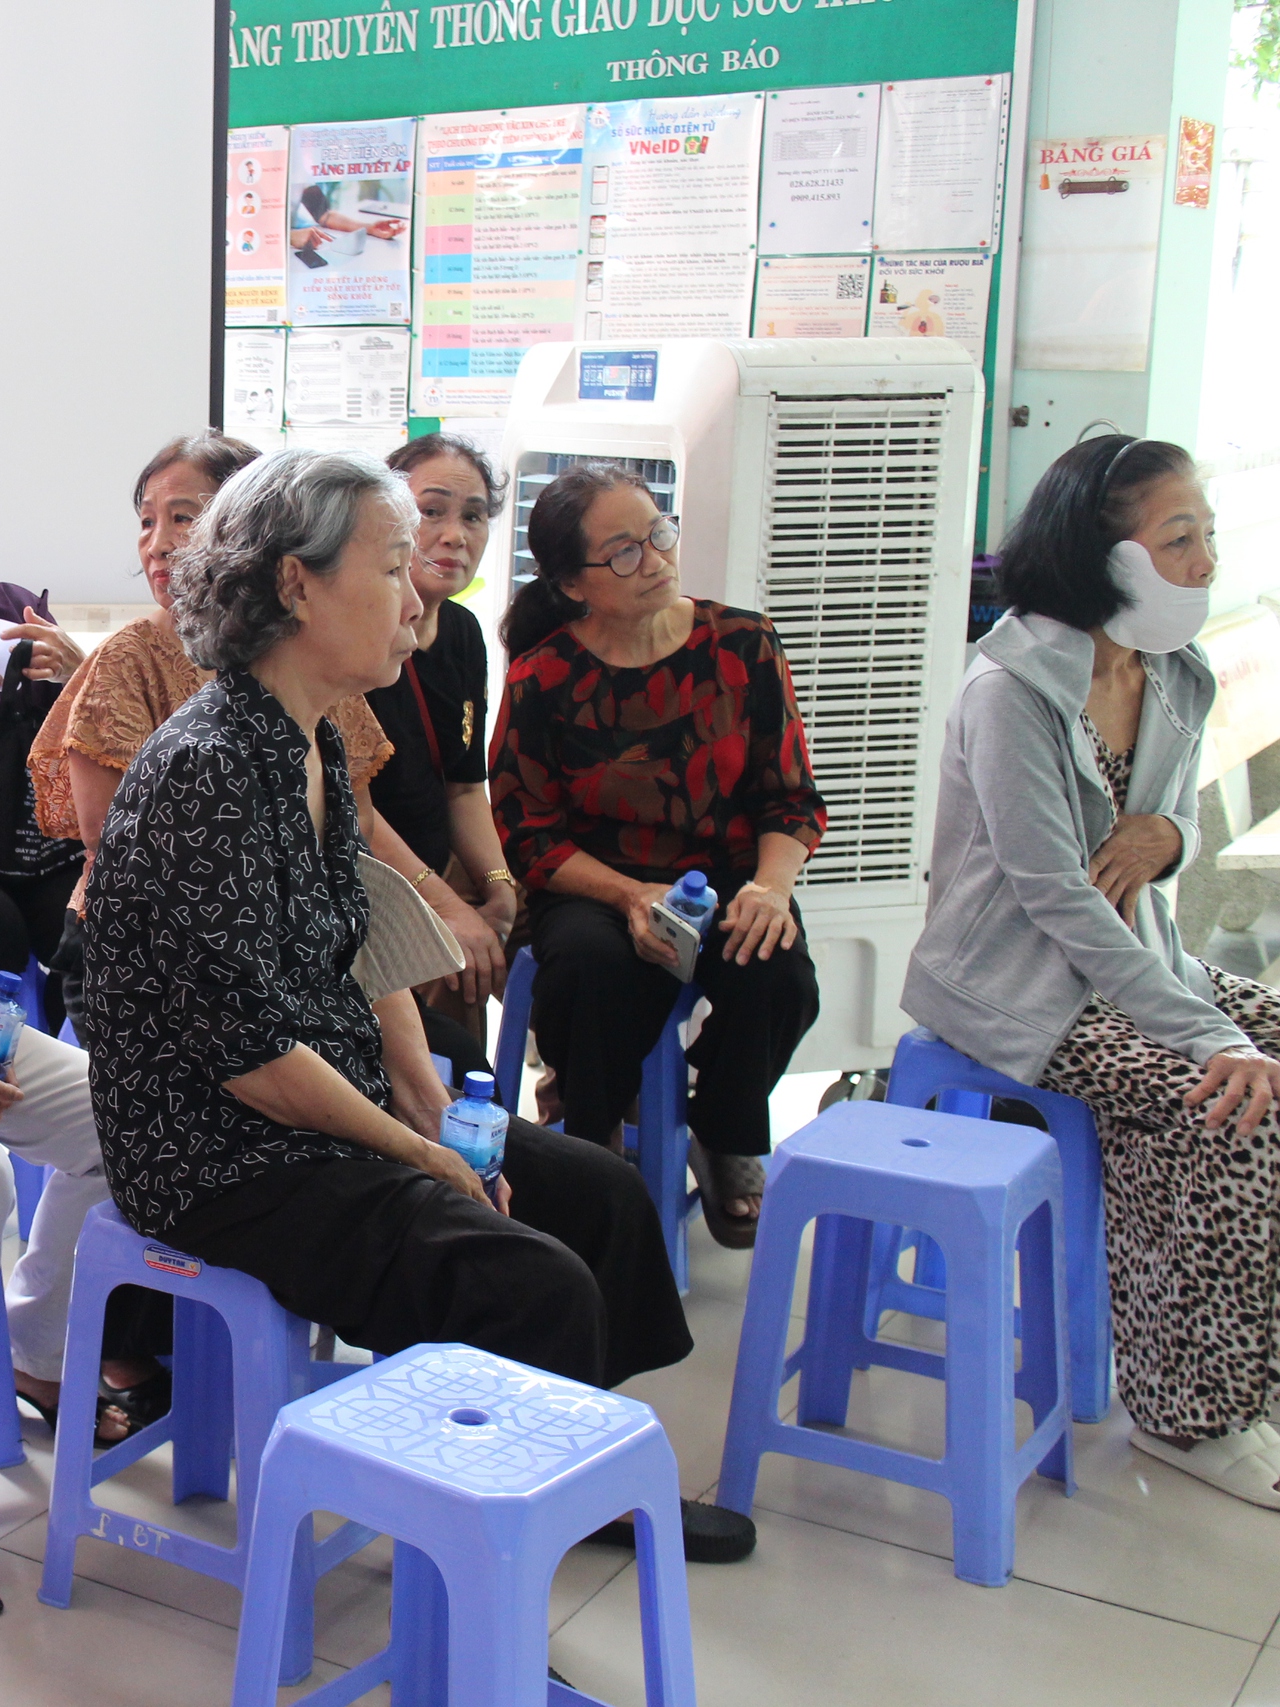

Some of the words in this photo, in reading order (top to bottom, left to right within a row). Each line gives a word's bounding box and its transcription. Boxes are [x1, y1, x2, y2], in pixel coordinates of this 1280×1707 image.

[607, 49, 708, 82] THÔNG
[721, 39, 779, 72] BÁO
[649, 108, 678, 123] Hướng
[681, 106, 699, 119] dẫn
[674, 122, 699, 135] ĐIỆN
[703, 119, 715, 132] TỬ
[351, 144, 380, 159] HIỆN
[629, 139, 680, 155] VNeID
[1040, 142, 1104, 164] BẢNG
[1112, 140, 1152, 162] GIÁ
[311, 162, 345, 176] TĂNG
[347, 159, 390, 175] HUYẾT
[393, 159, 411, 173] ÁP
[789, 179, 844, 188] 028.628.21433
[791, 193, 841, 202] 0909.415.893
[949, 259, 970, 267] RƯỢU
